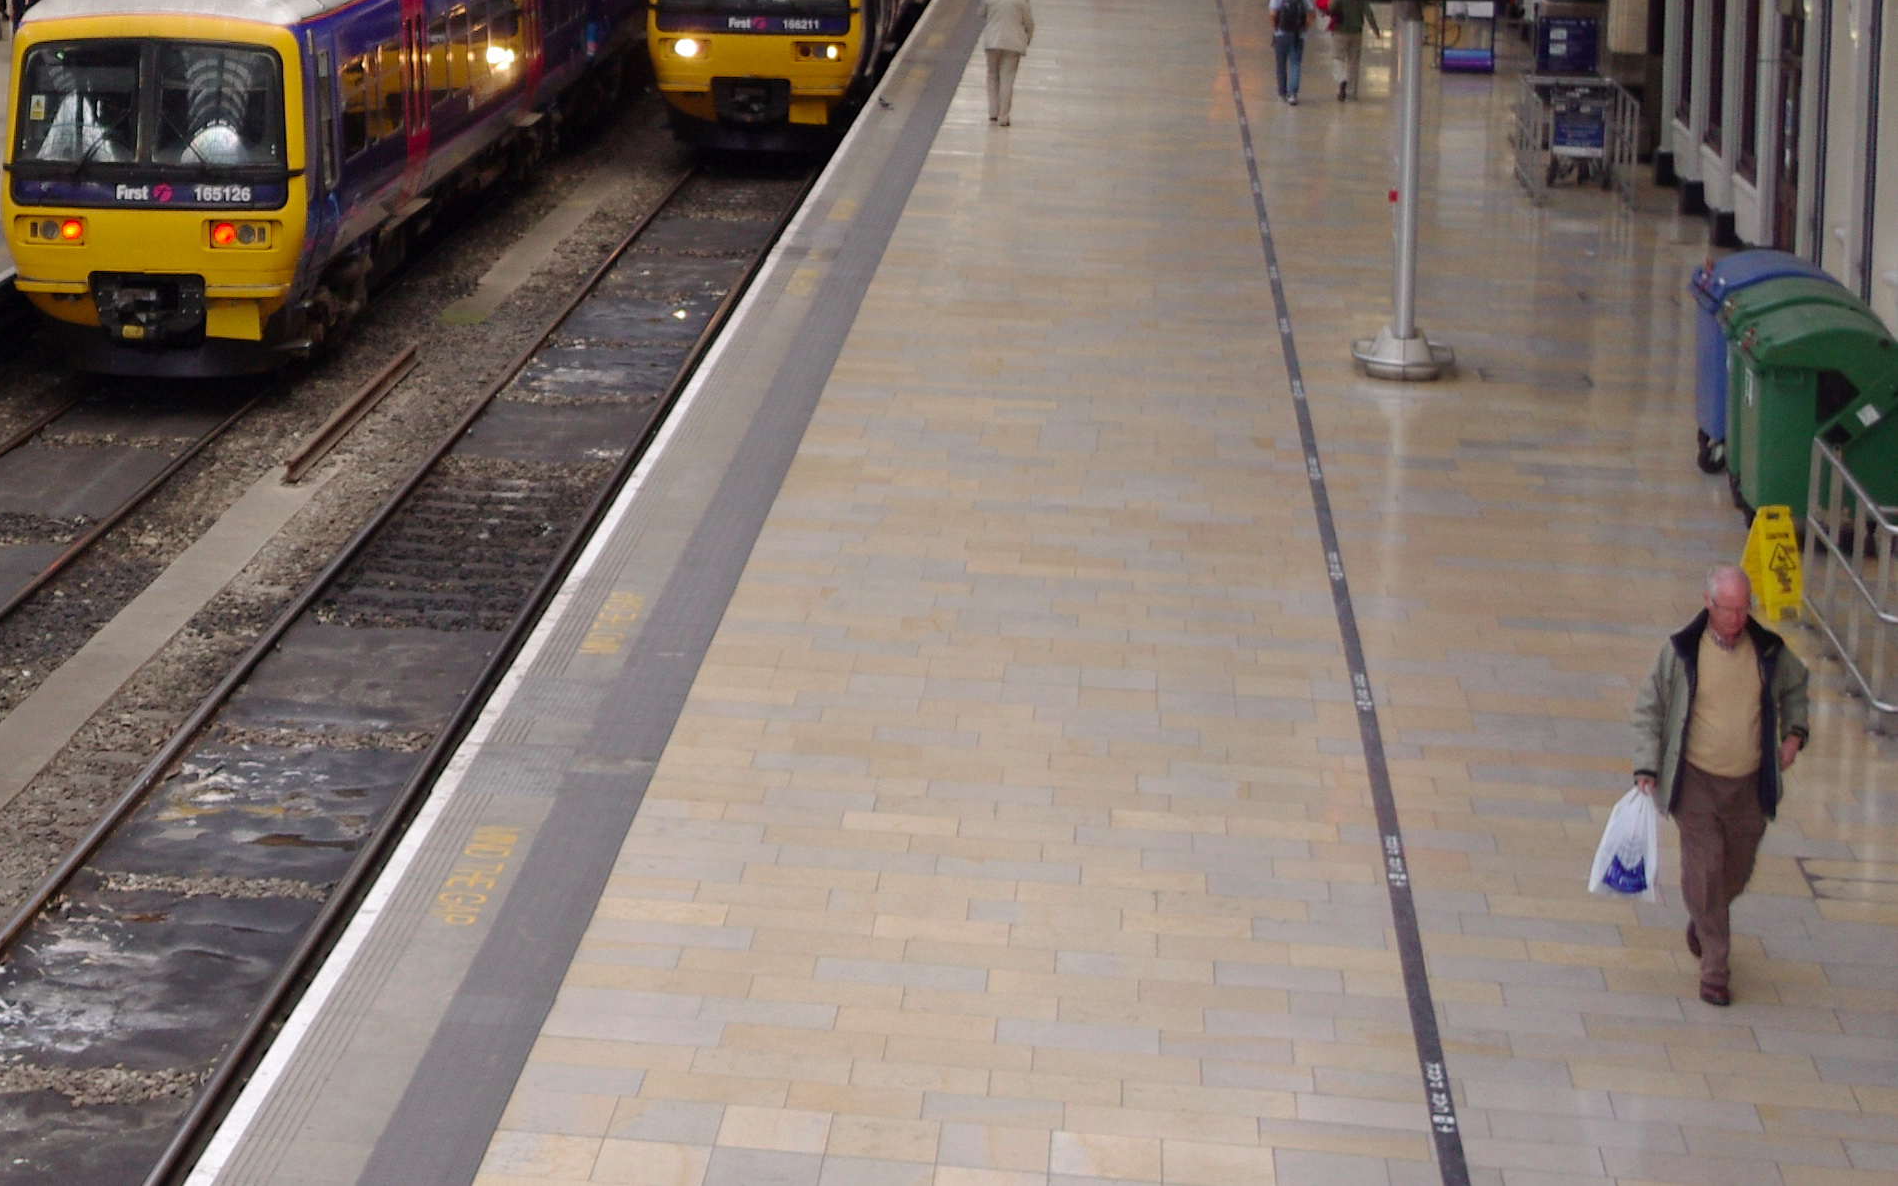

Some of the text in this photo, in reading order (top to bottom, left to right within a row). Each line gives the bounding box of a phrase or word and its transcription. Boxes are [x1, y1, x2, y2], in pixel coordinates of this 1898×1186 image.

[727, 17, 752, 29] First
[115, 183, 252, 202] First 165126
